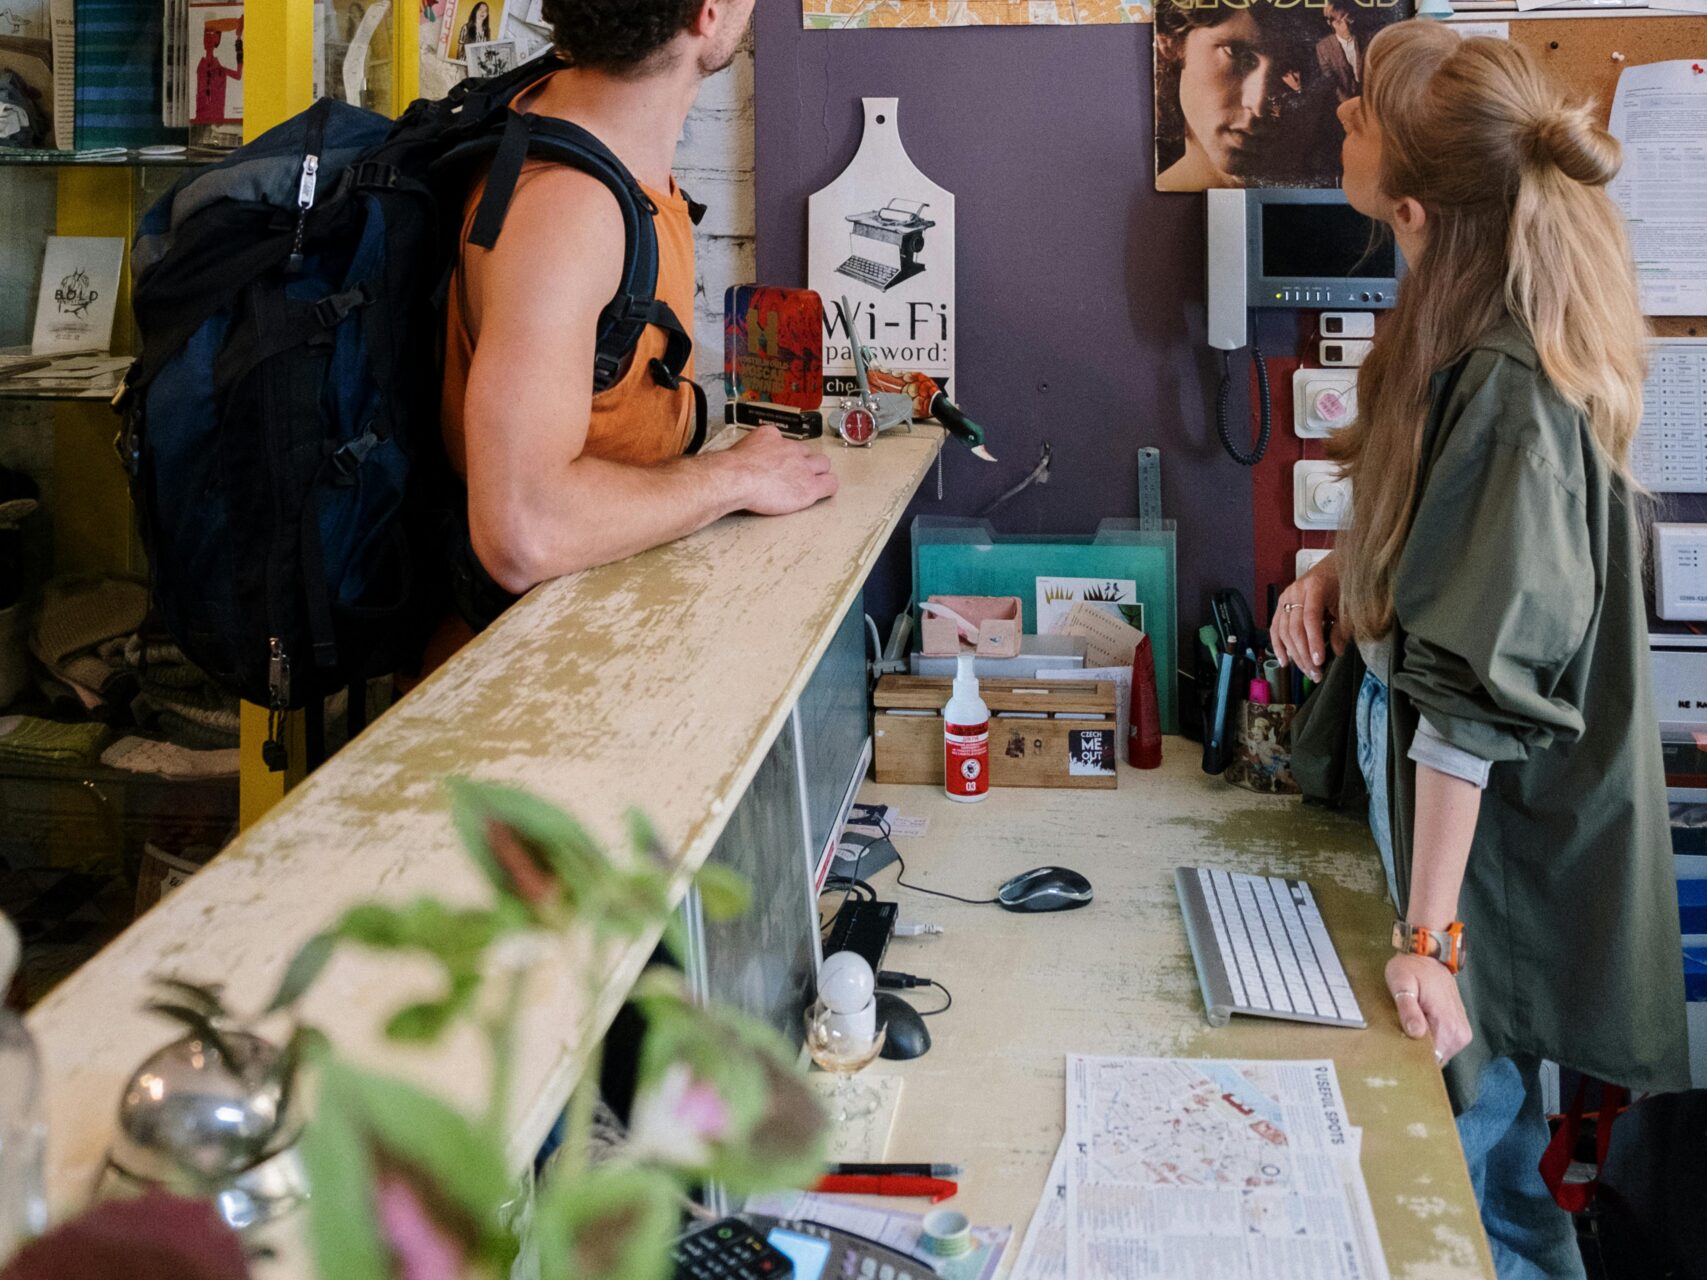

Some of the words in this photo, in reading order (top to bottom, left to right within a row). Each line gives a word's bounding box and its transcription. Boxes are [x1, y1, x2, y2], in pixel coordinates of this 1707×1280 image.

[54, 288, 99, 302] BOLD
[822, 300, 948, 340] Wi-Fi
[825, 342, 948, 366] pasword:
[1081, 738, 1103, 751] ME
[1081, 751, 1103, 761] OUT
[1315, 1072, 1335, 1109] USEFUL
[1324, 1110, 1345, 1146] SPOTS
